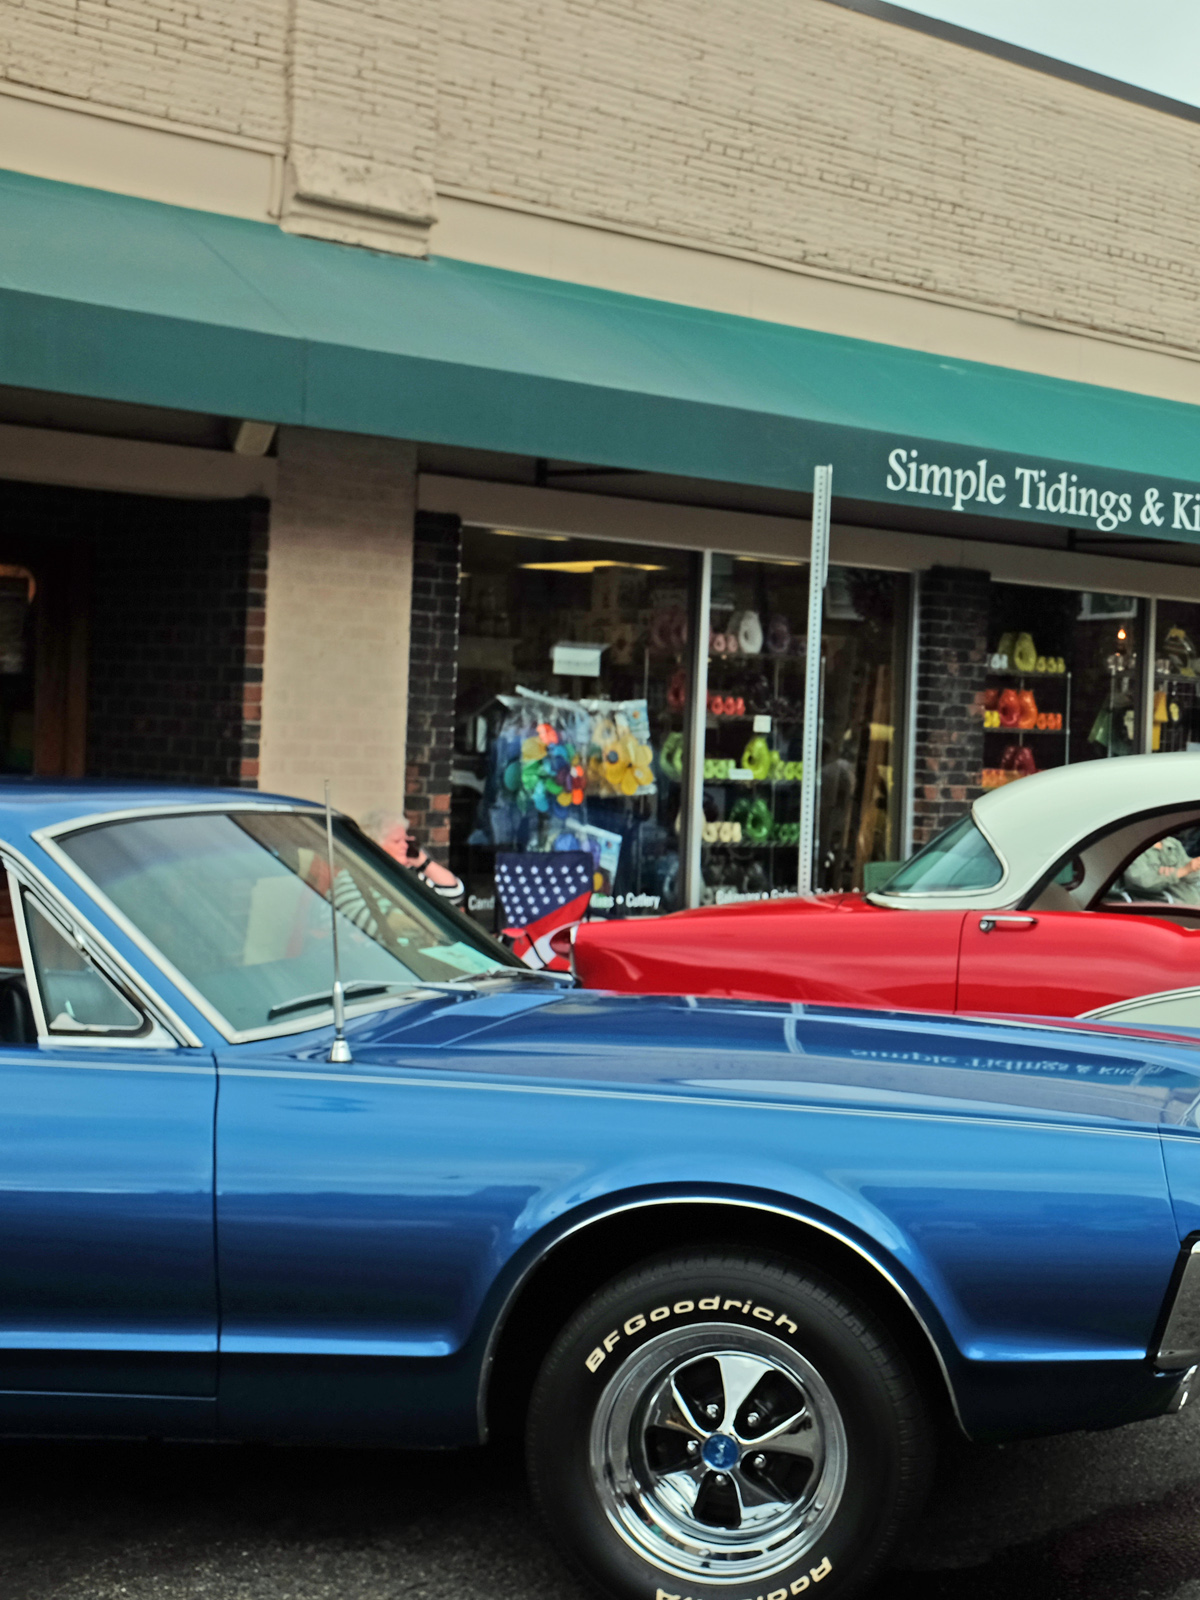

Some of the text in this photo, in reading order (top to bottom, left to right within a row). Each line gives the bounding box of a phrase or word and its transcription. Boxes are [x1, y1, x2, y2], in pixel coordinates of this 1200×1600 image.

[886, 447, 1007, 511] Simple
[1015, 466, 1132, 532] Tidings
[1139, 487, 1165, 527] &
[584, 1295, 799, 1374] BFGoodrich
